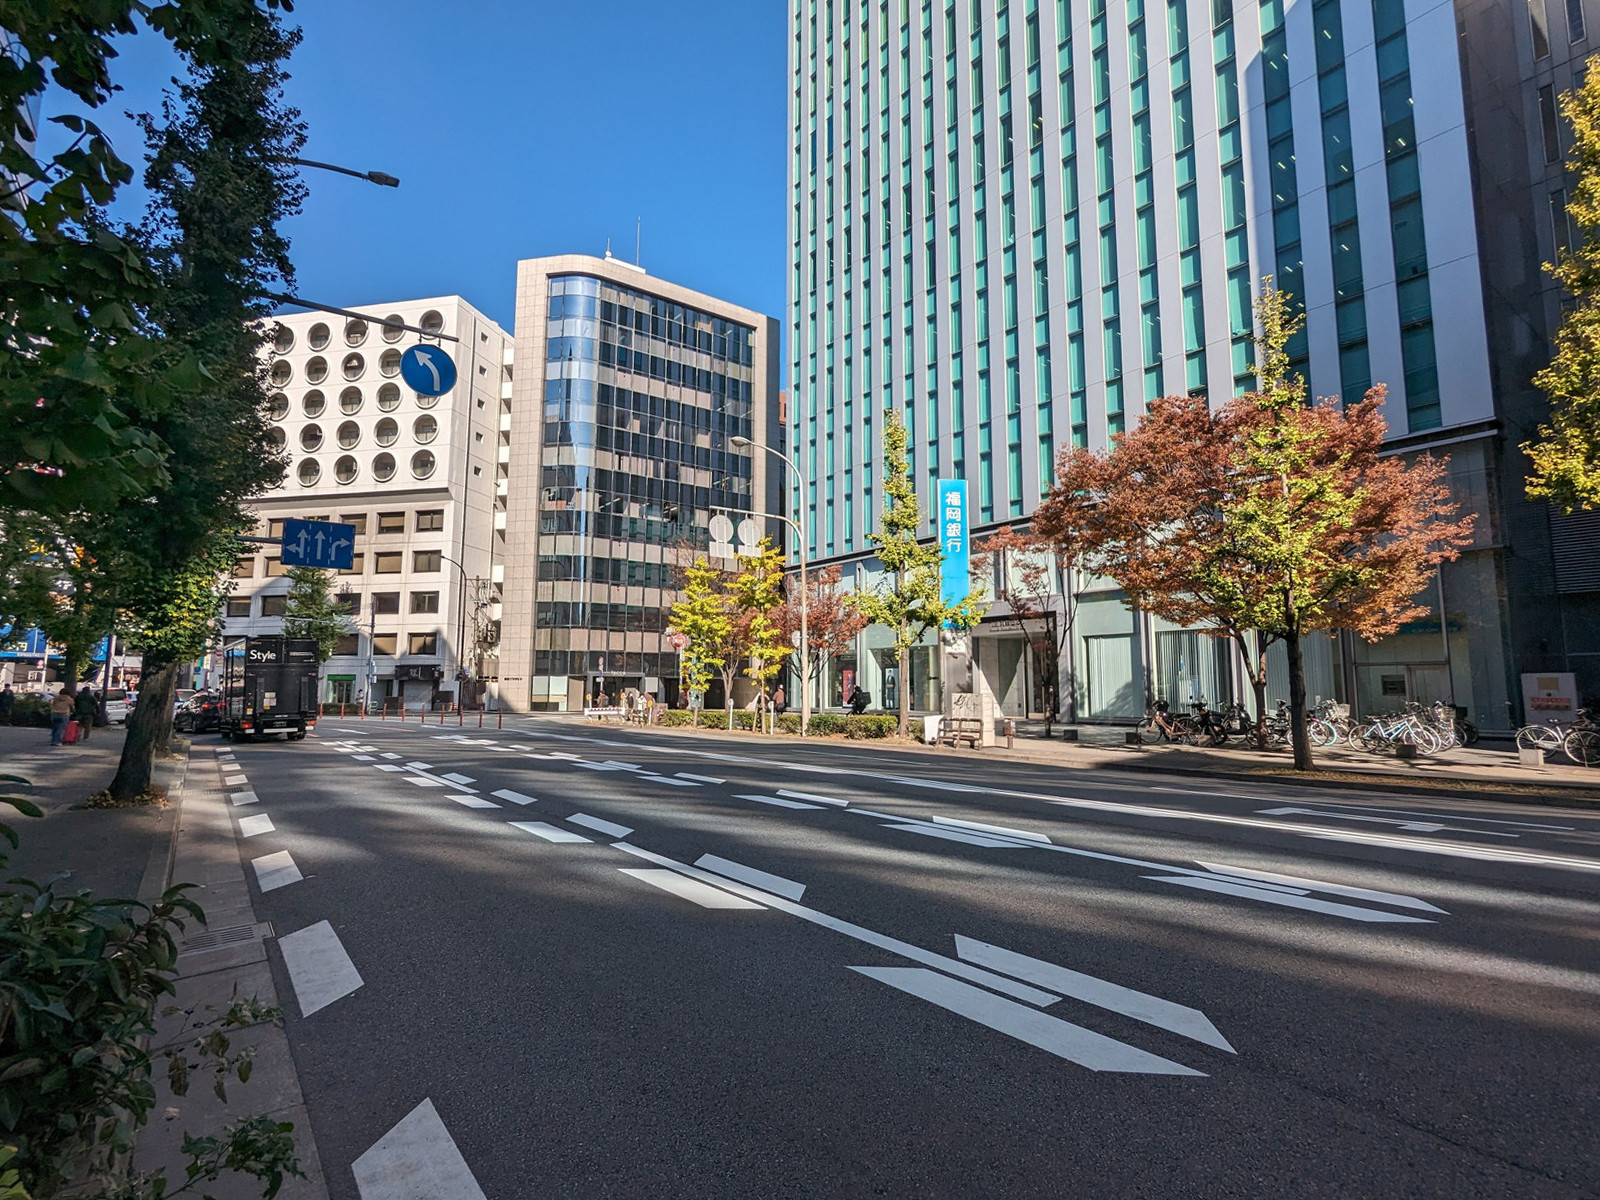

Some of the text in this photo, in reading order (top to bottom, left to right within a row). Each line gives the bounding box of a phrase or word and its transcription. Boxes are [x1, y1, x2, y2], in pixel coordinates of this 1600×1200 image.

[945, 491, 962, 553] 福岡銀行
[249, 649, 277, 662] Style
